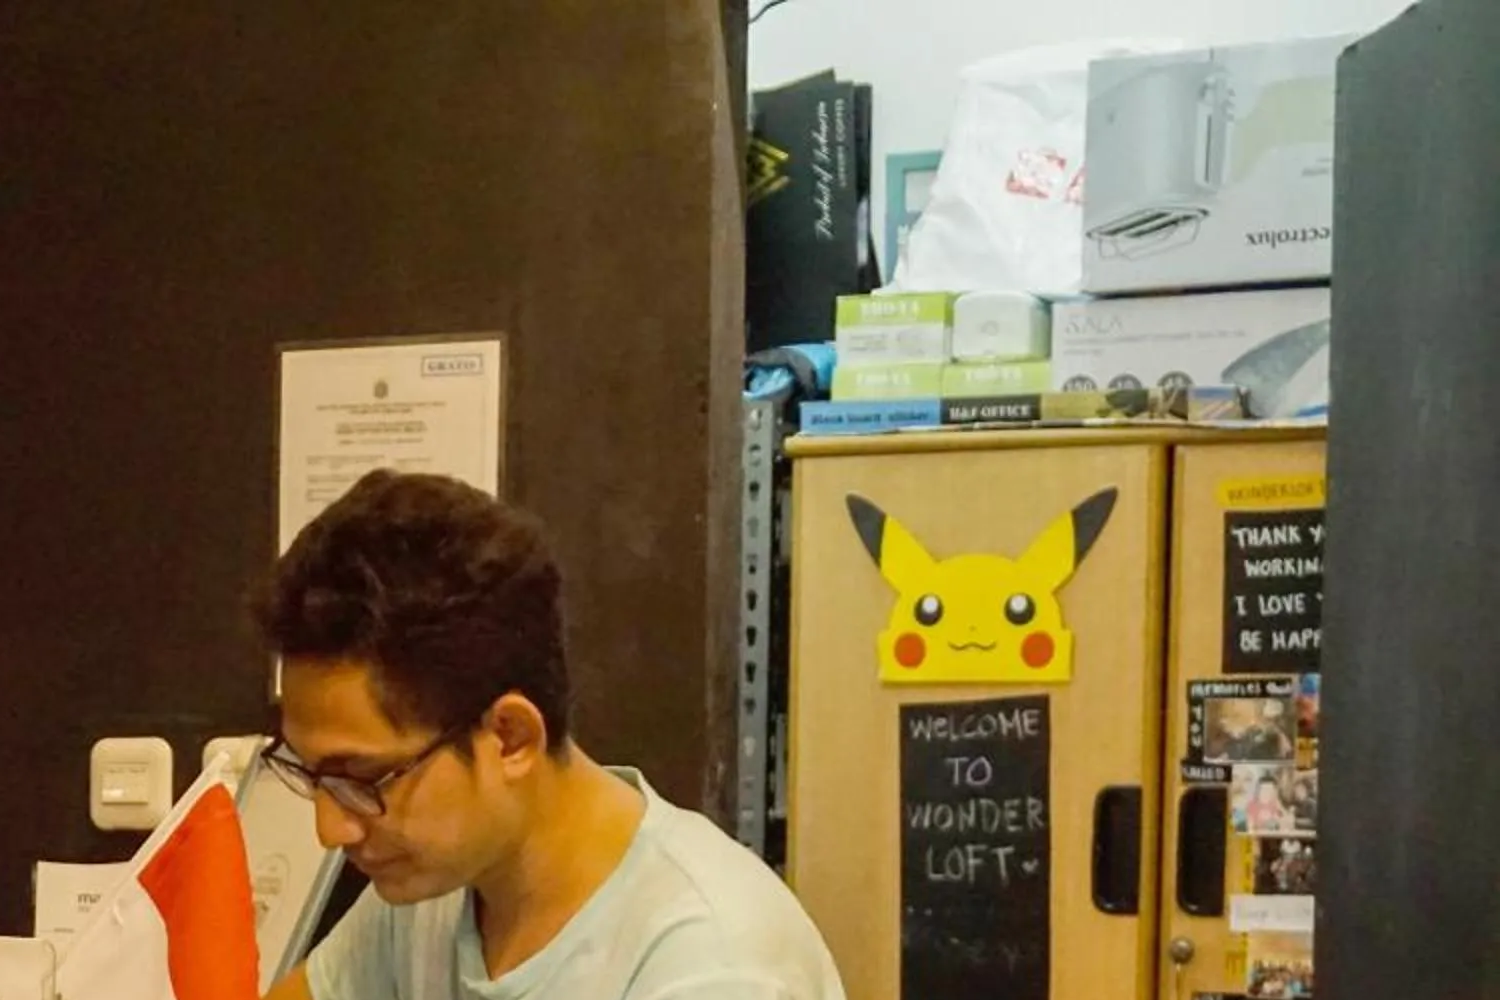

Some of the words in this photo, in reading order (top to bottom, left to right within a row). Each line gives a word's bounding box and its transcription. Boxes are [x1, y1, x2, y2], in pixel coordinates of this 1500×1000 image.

[1245, 226, 1331, 249] ectrolux
[1231, 524, 1301, 549] THANK
[1243, 556, 1324, 578] WORKIN
[1235, 595, 1248, 616] I
[1258, 592, 1306, 617] LOVE
[1240, 629, 1263, 653] BE
[1272, 628, 1322, 650] HAPP
[945, 755, 994, 787] TO
[907, 795, 1045, 834] WONDER
[925, 843, 1016, 886] LOFT
